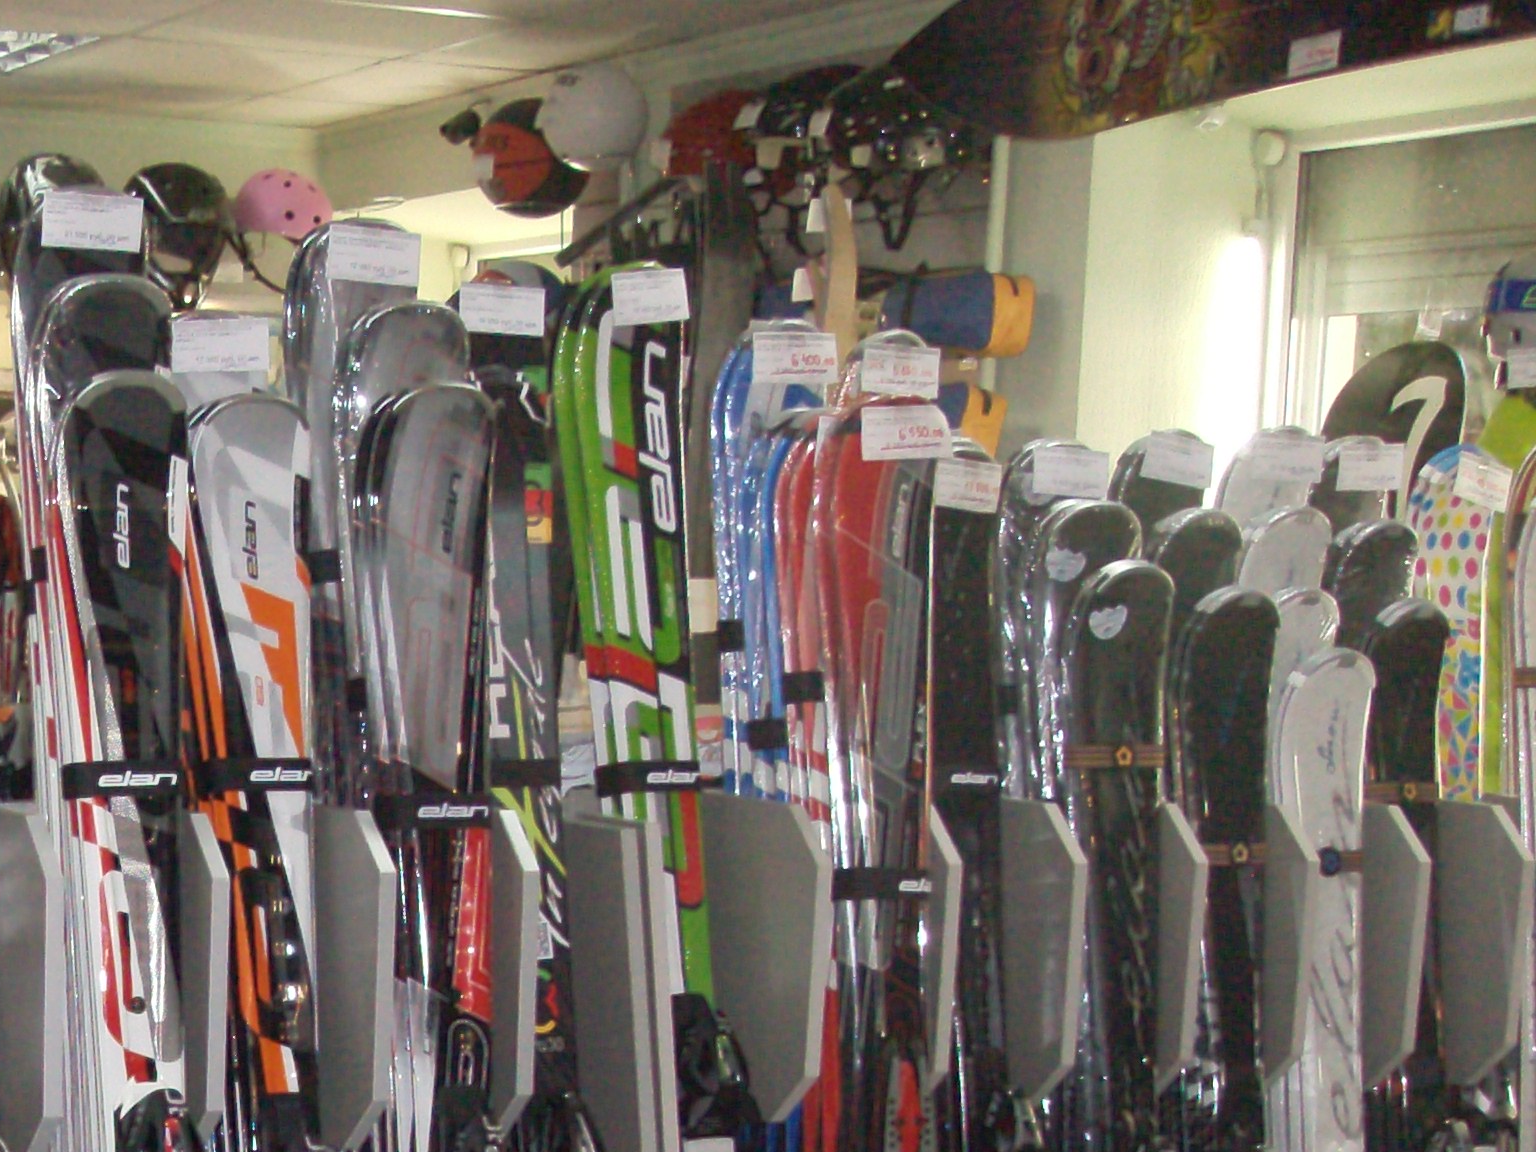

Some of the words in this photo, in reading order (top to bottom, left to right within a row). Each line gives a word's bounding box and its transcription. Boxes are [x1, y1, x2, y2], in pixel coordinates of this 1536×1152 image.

[639, 340, 677, 534] elan
[111, 482, 131, 570] elan
[240, 501, 258, 580] elan
[98, 771, 178, 787] elan
[417, 802, 489, 820] elan
